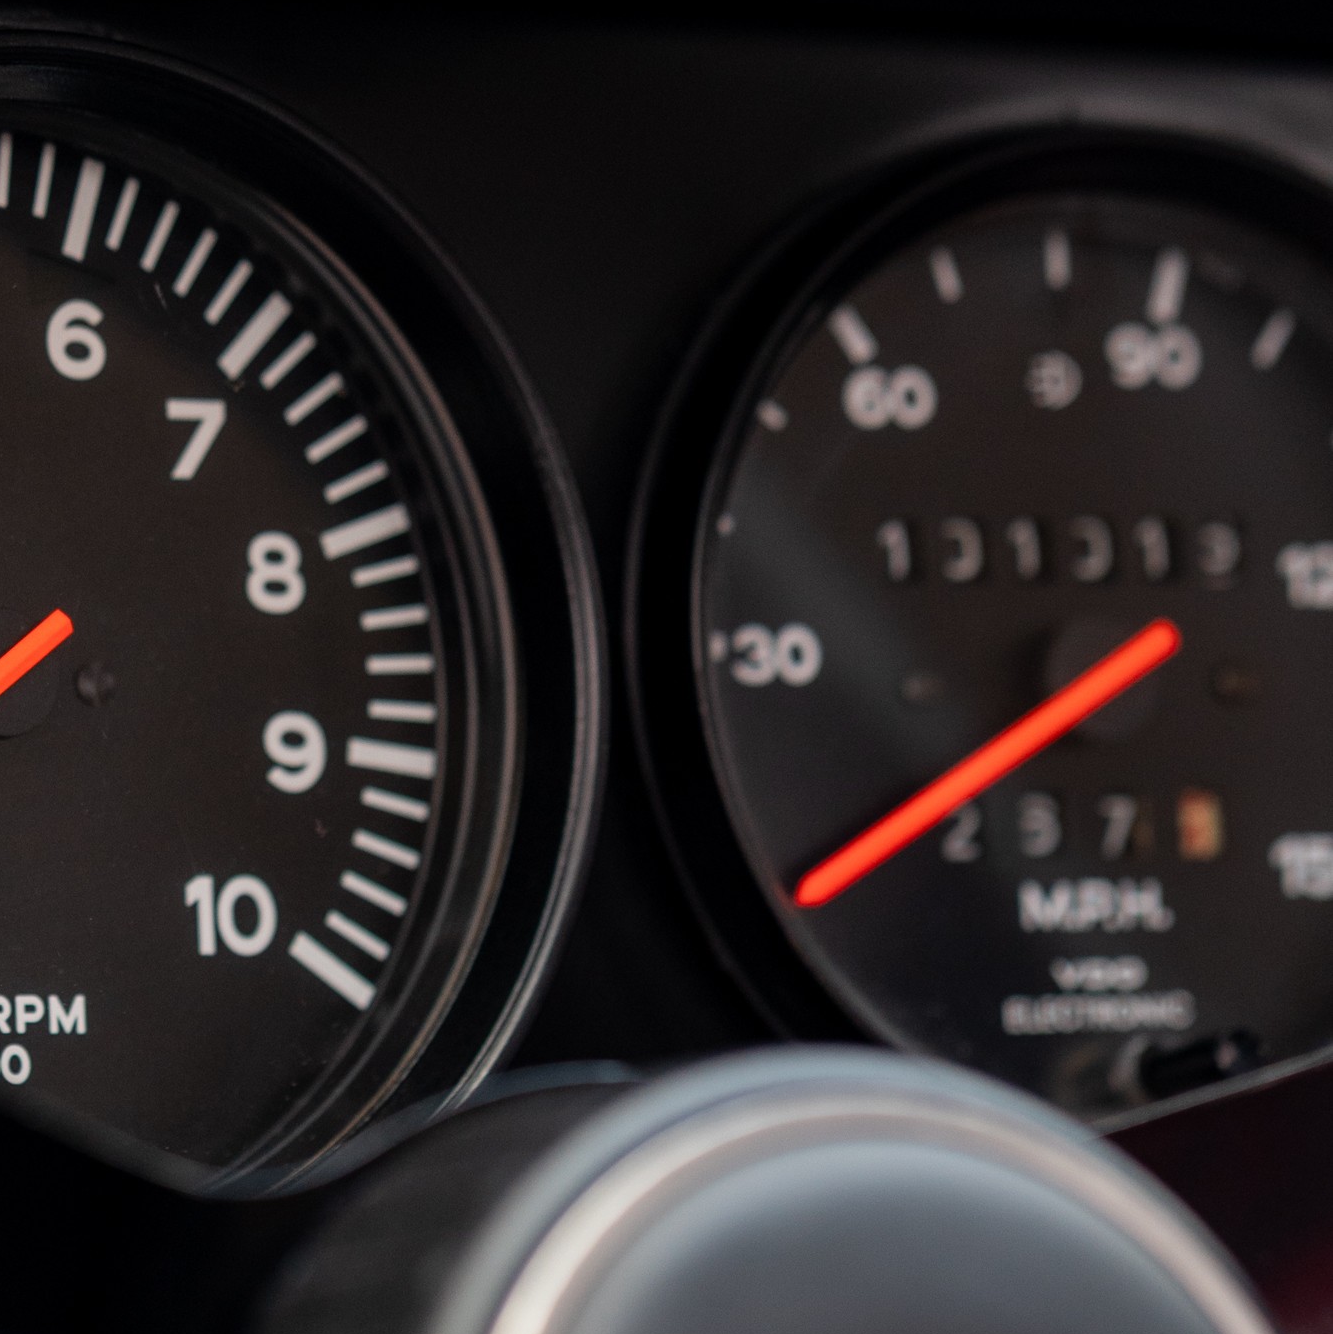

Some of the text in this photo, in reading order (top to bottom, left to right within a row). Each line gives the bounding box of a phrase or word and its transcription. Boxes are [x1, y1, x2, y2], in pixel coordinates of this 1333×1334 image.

[46, 299, 107, 381] 6
[842, 365, 937, 430] 60
[166, 399, 226, 480] 7
[245, 531, 307, 615] 8
[731, 623, 823, 687] 30
[263, 710, 327, 793] 9
[184, 874, 278, 957] 10
